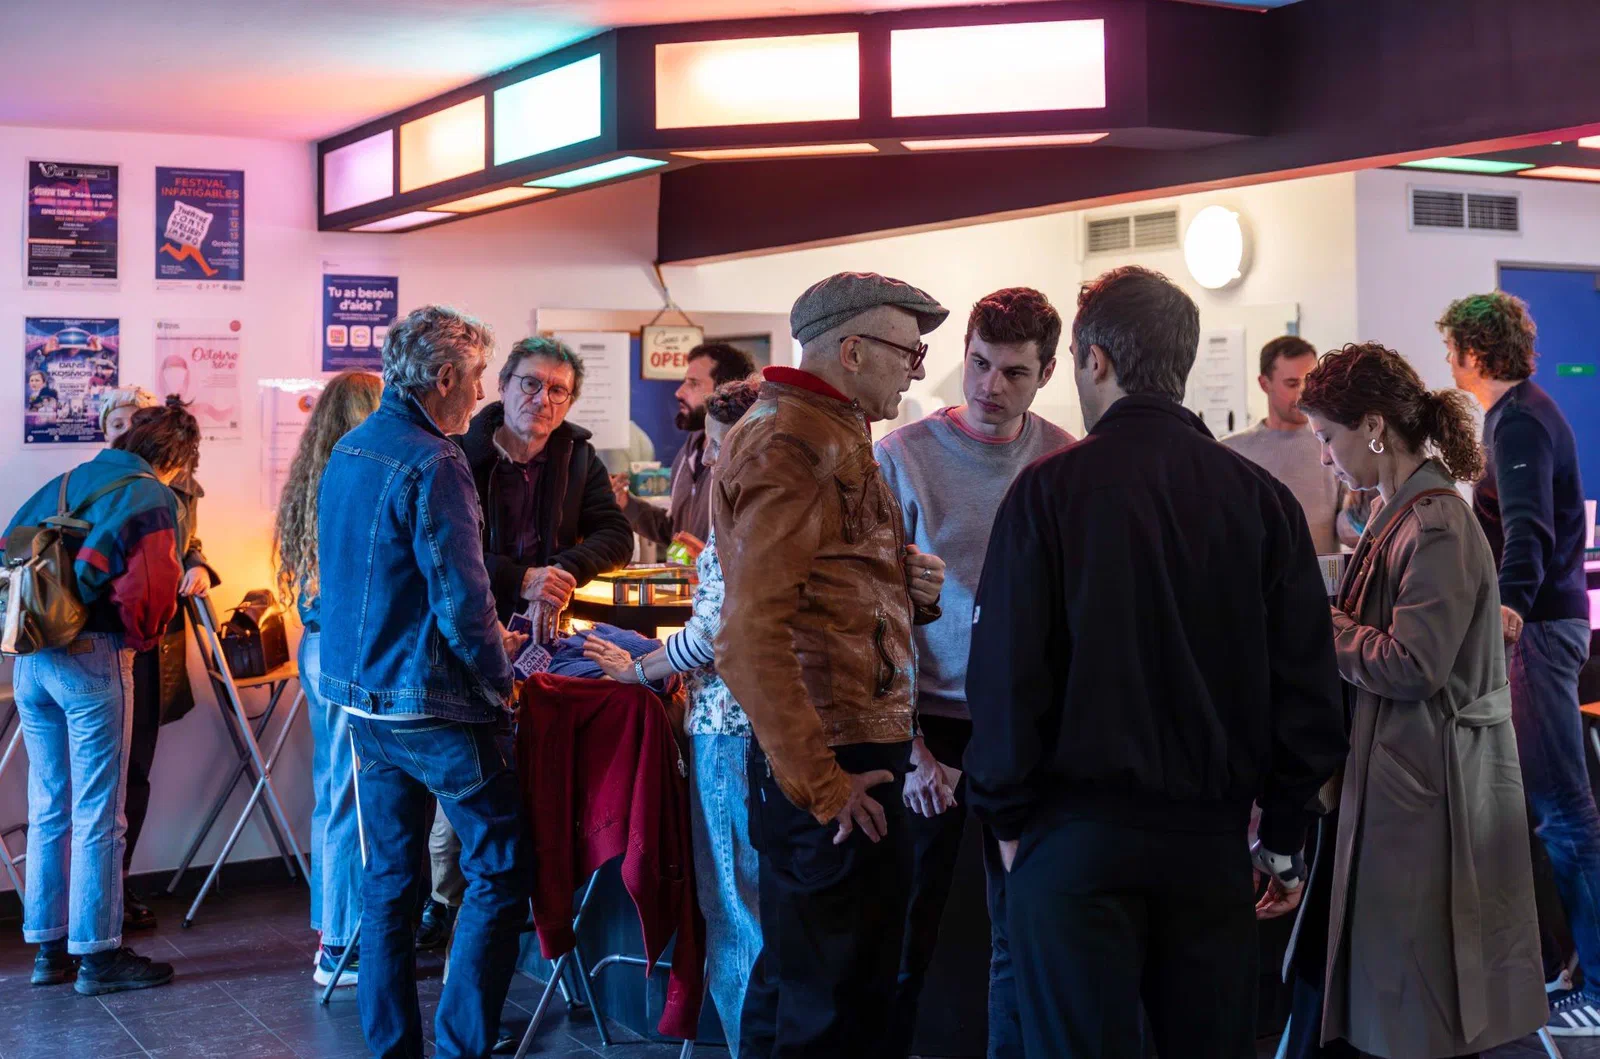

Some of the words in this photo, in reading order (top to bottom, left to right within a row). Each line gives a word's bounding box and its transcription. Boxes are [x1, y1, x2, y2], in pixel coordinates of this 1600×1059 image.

[174, 177, 226, 189] FESTIVAL
[161, 187, 239, 199] INFATIGABLES
[328, 287, 342, 297] Tu
[343, 289, 356, 298] as
[358, 287, 394, 299] besoin
[339, 299, 373, 311] d'aide
[375, 300, 382, 311] ?
[192, 347, 238, 362] Octobre
